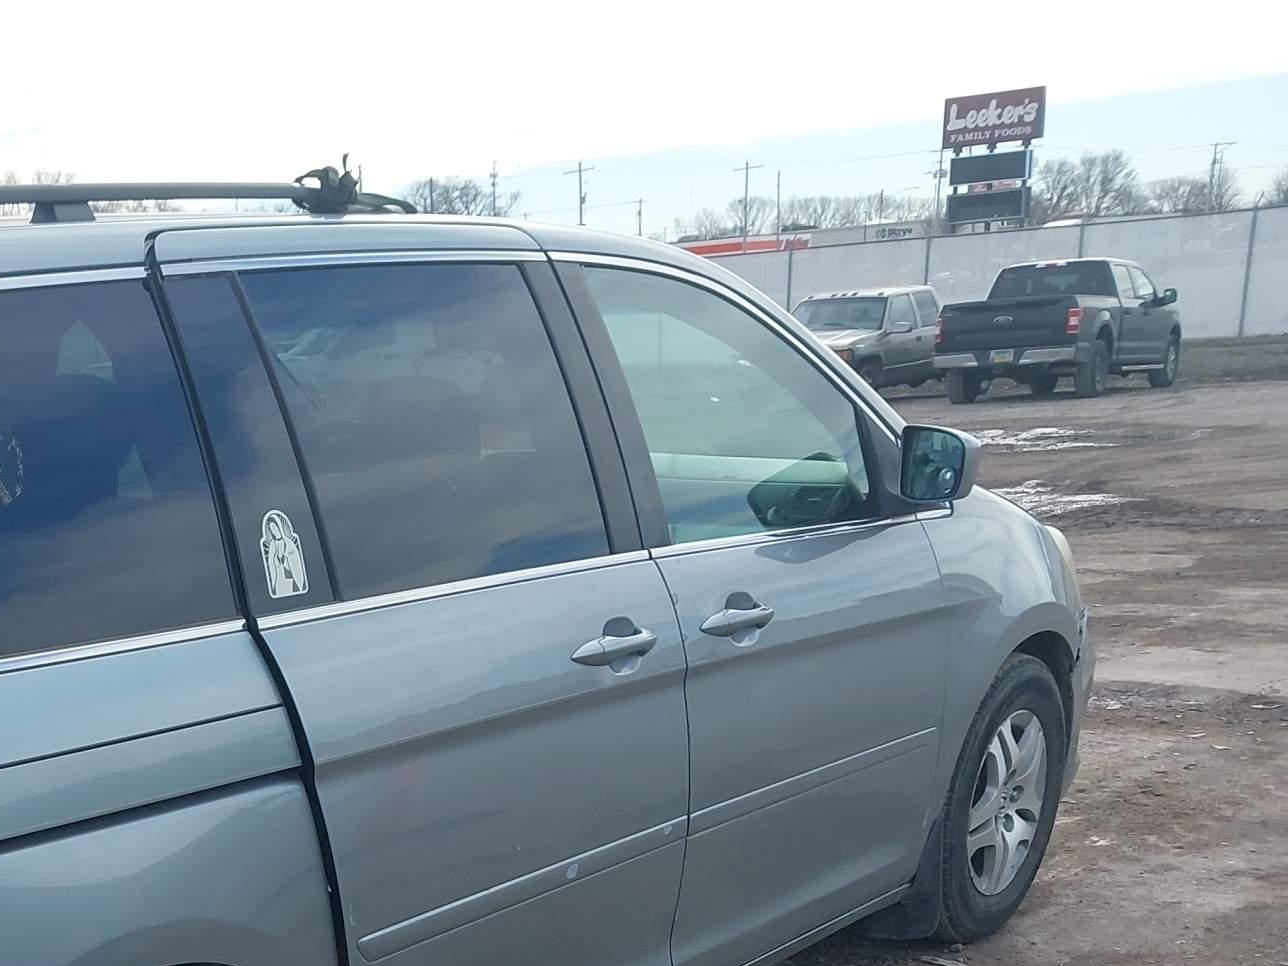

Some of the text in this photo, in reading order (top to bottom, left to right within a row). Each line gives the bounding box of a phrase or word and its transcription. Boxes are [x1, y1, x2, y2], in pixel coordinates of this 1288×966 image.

[946, 98, 1039, 131] Leeker's
[950, 125, 1032, 142] FAMILY FOODS
